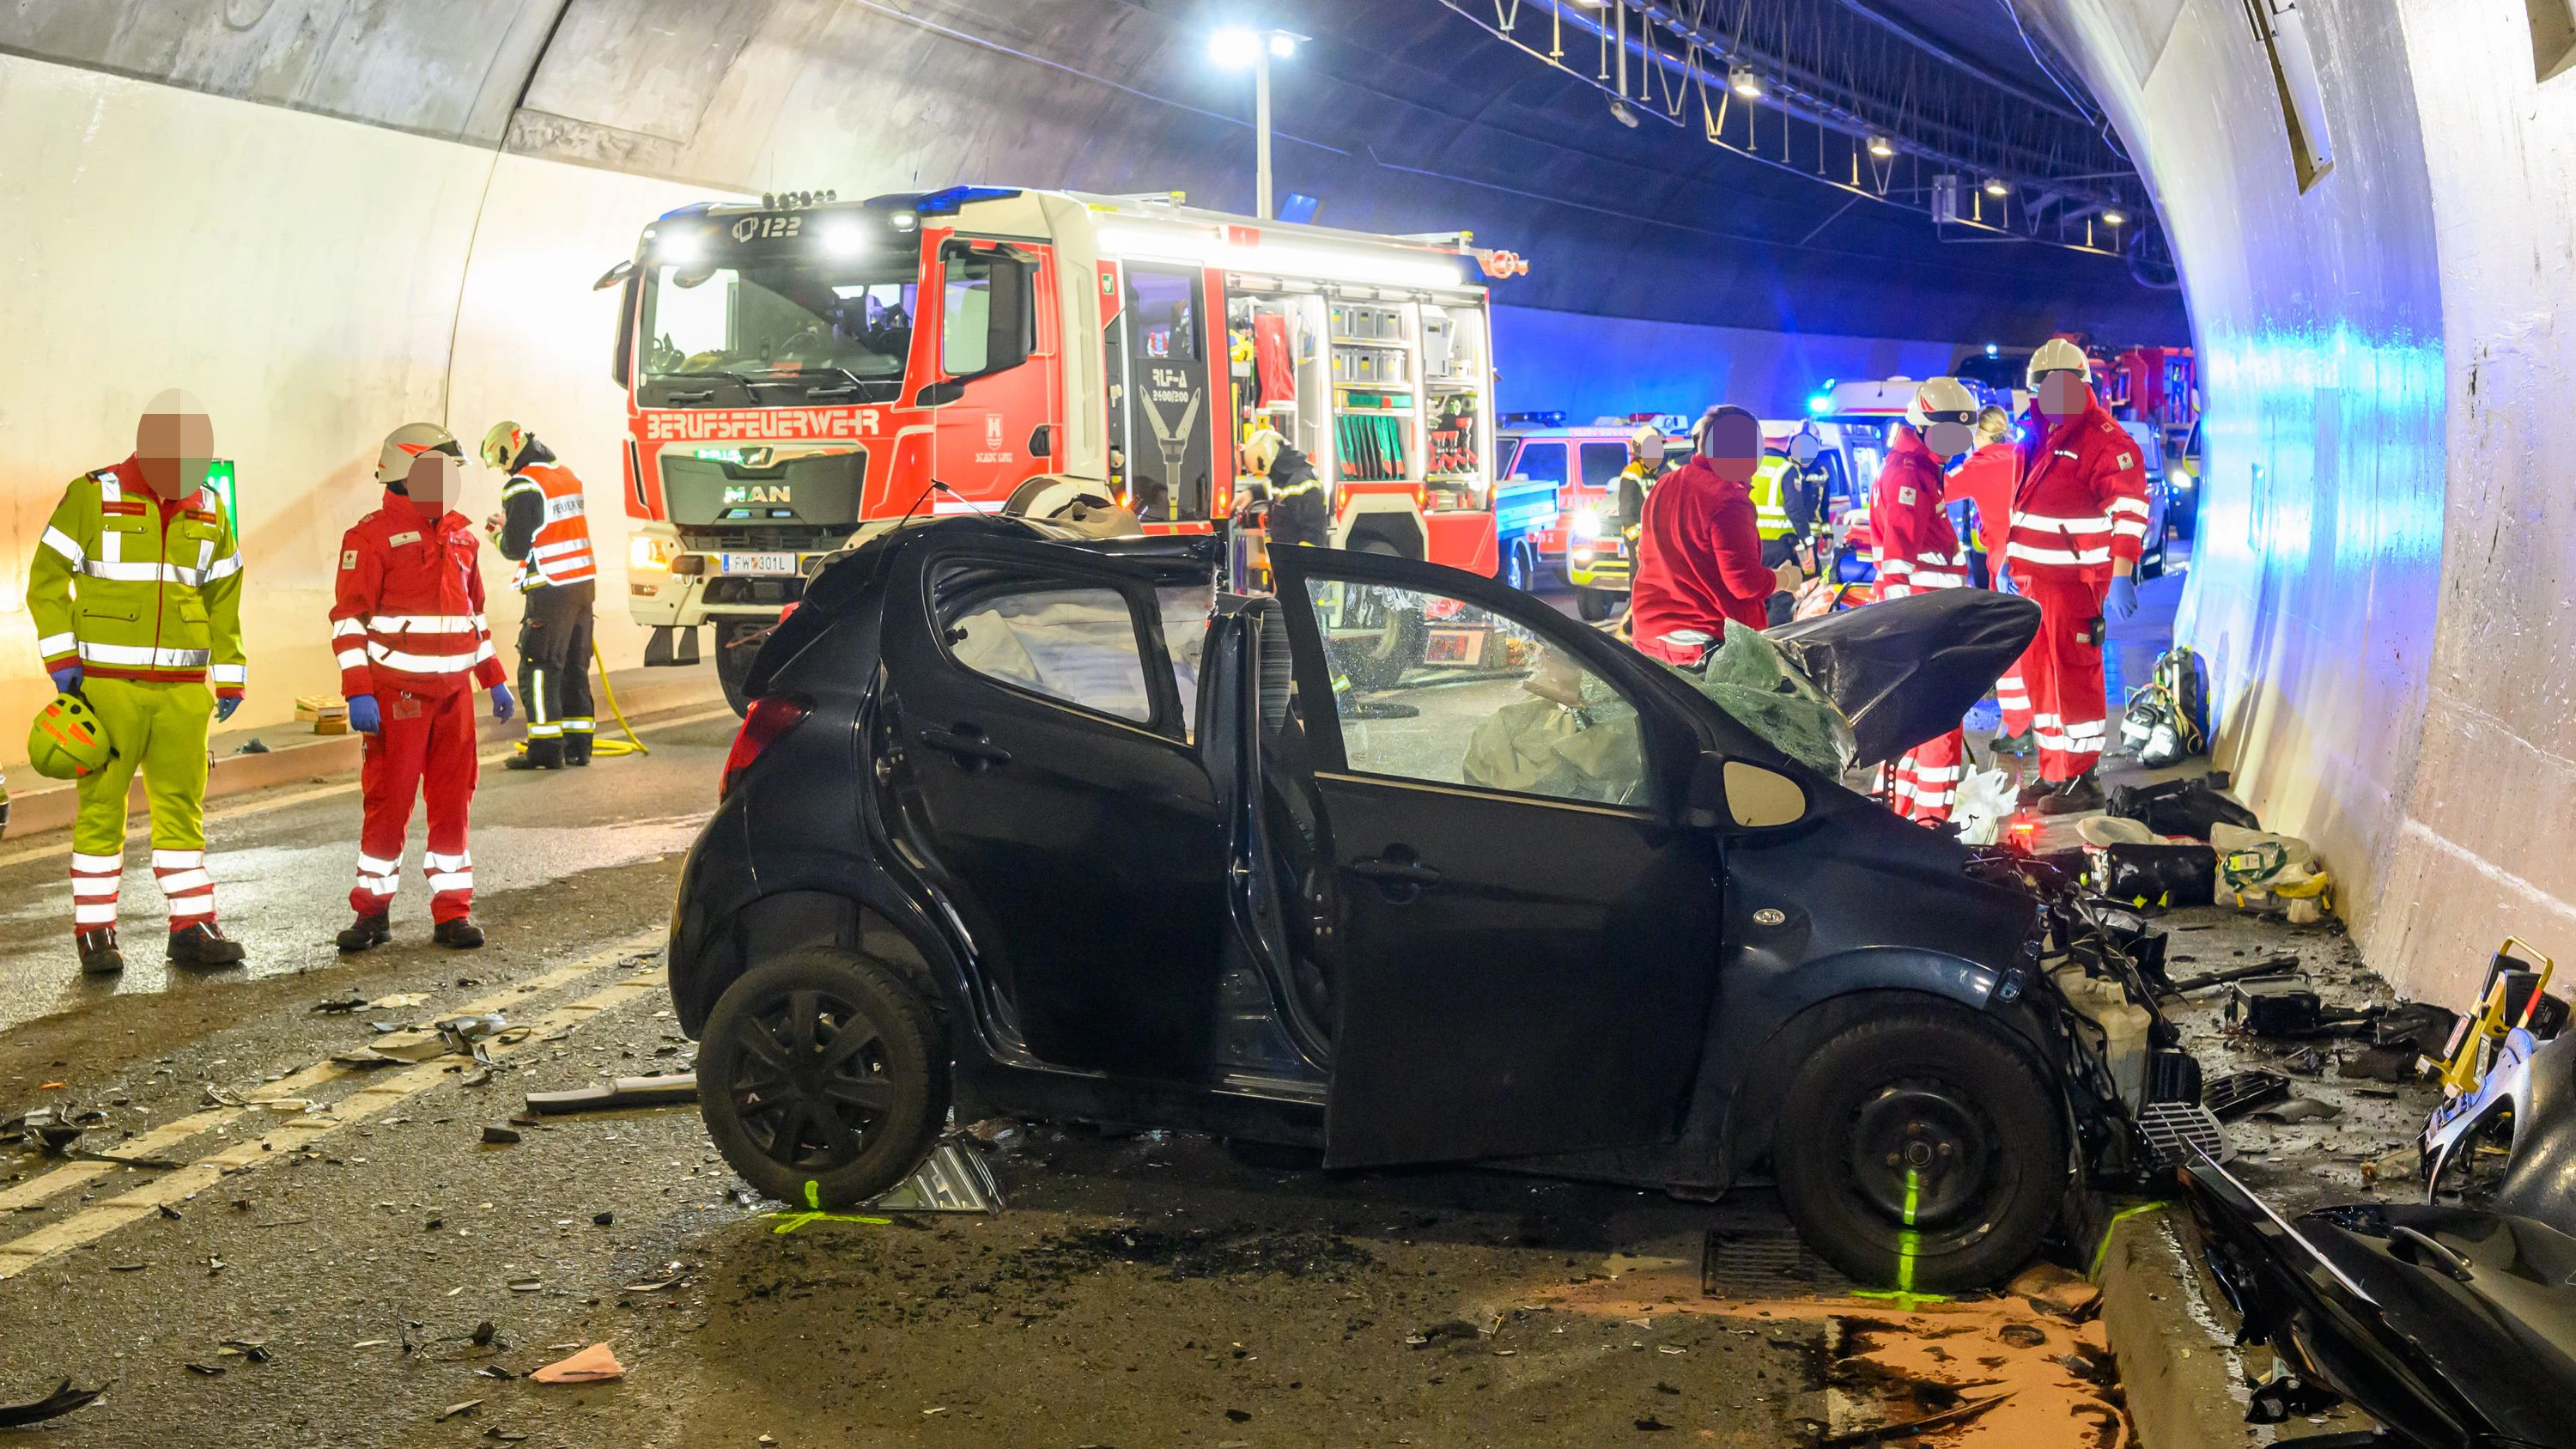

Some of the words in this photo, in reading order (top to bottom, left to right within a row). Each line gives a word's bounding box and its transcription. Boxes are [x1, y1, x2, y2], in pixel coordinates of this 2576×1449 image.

[762, 216, 802, 237] 122
[1152, 368, 1188, 387] RLF-A
[647, 409, 879, 439] BERUFSFEUERWEHR
[724, 485, 791, 503] MAN
